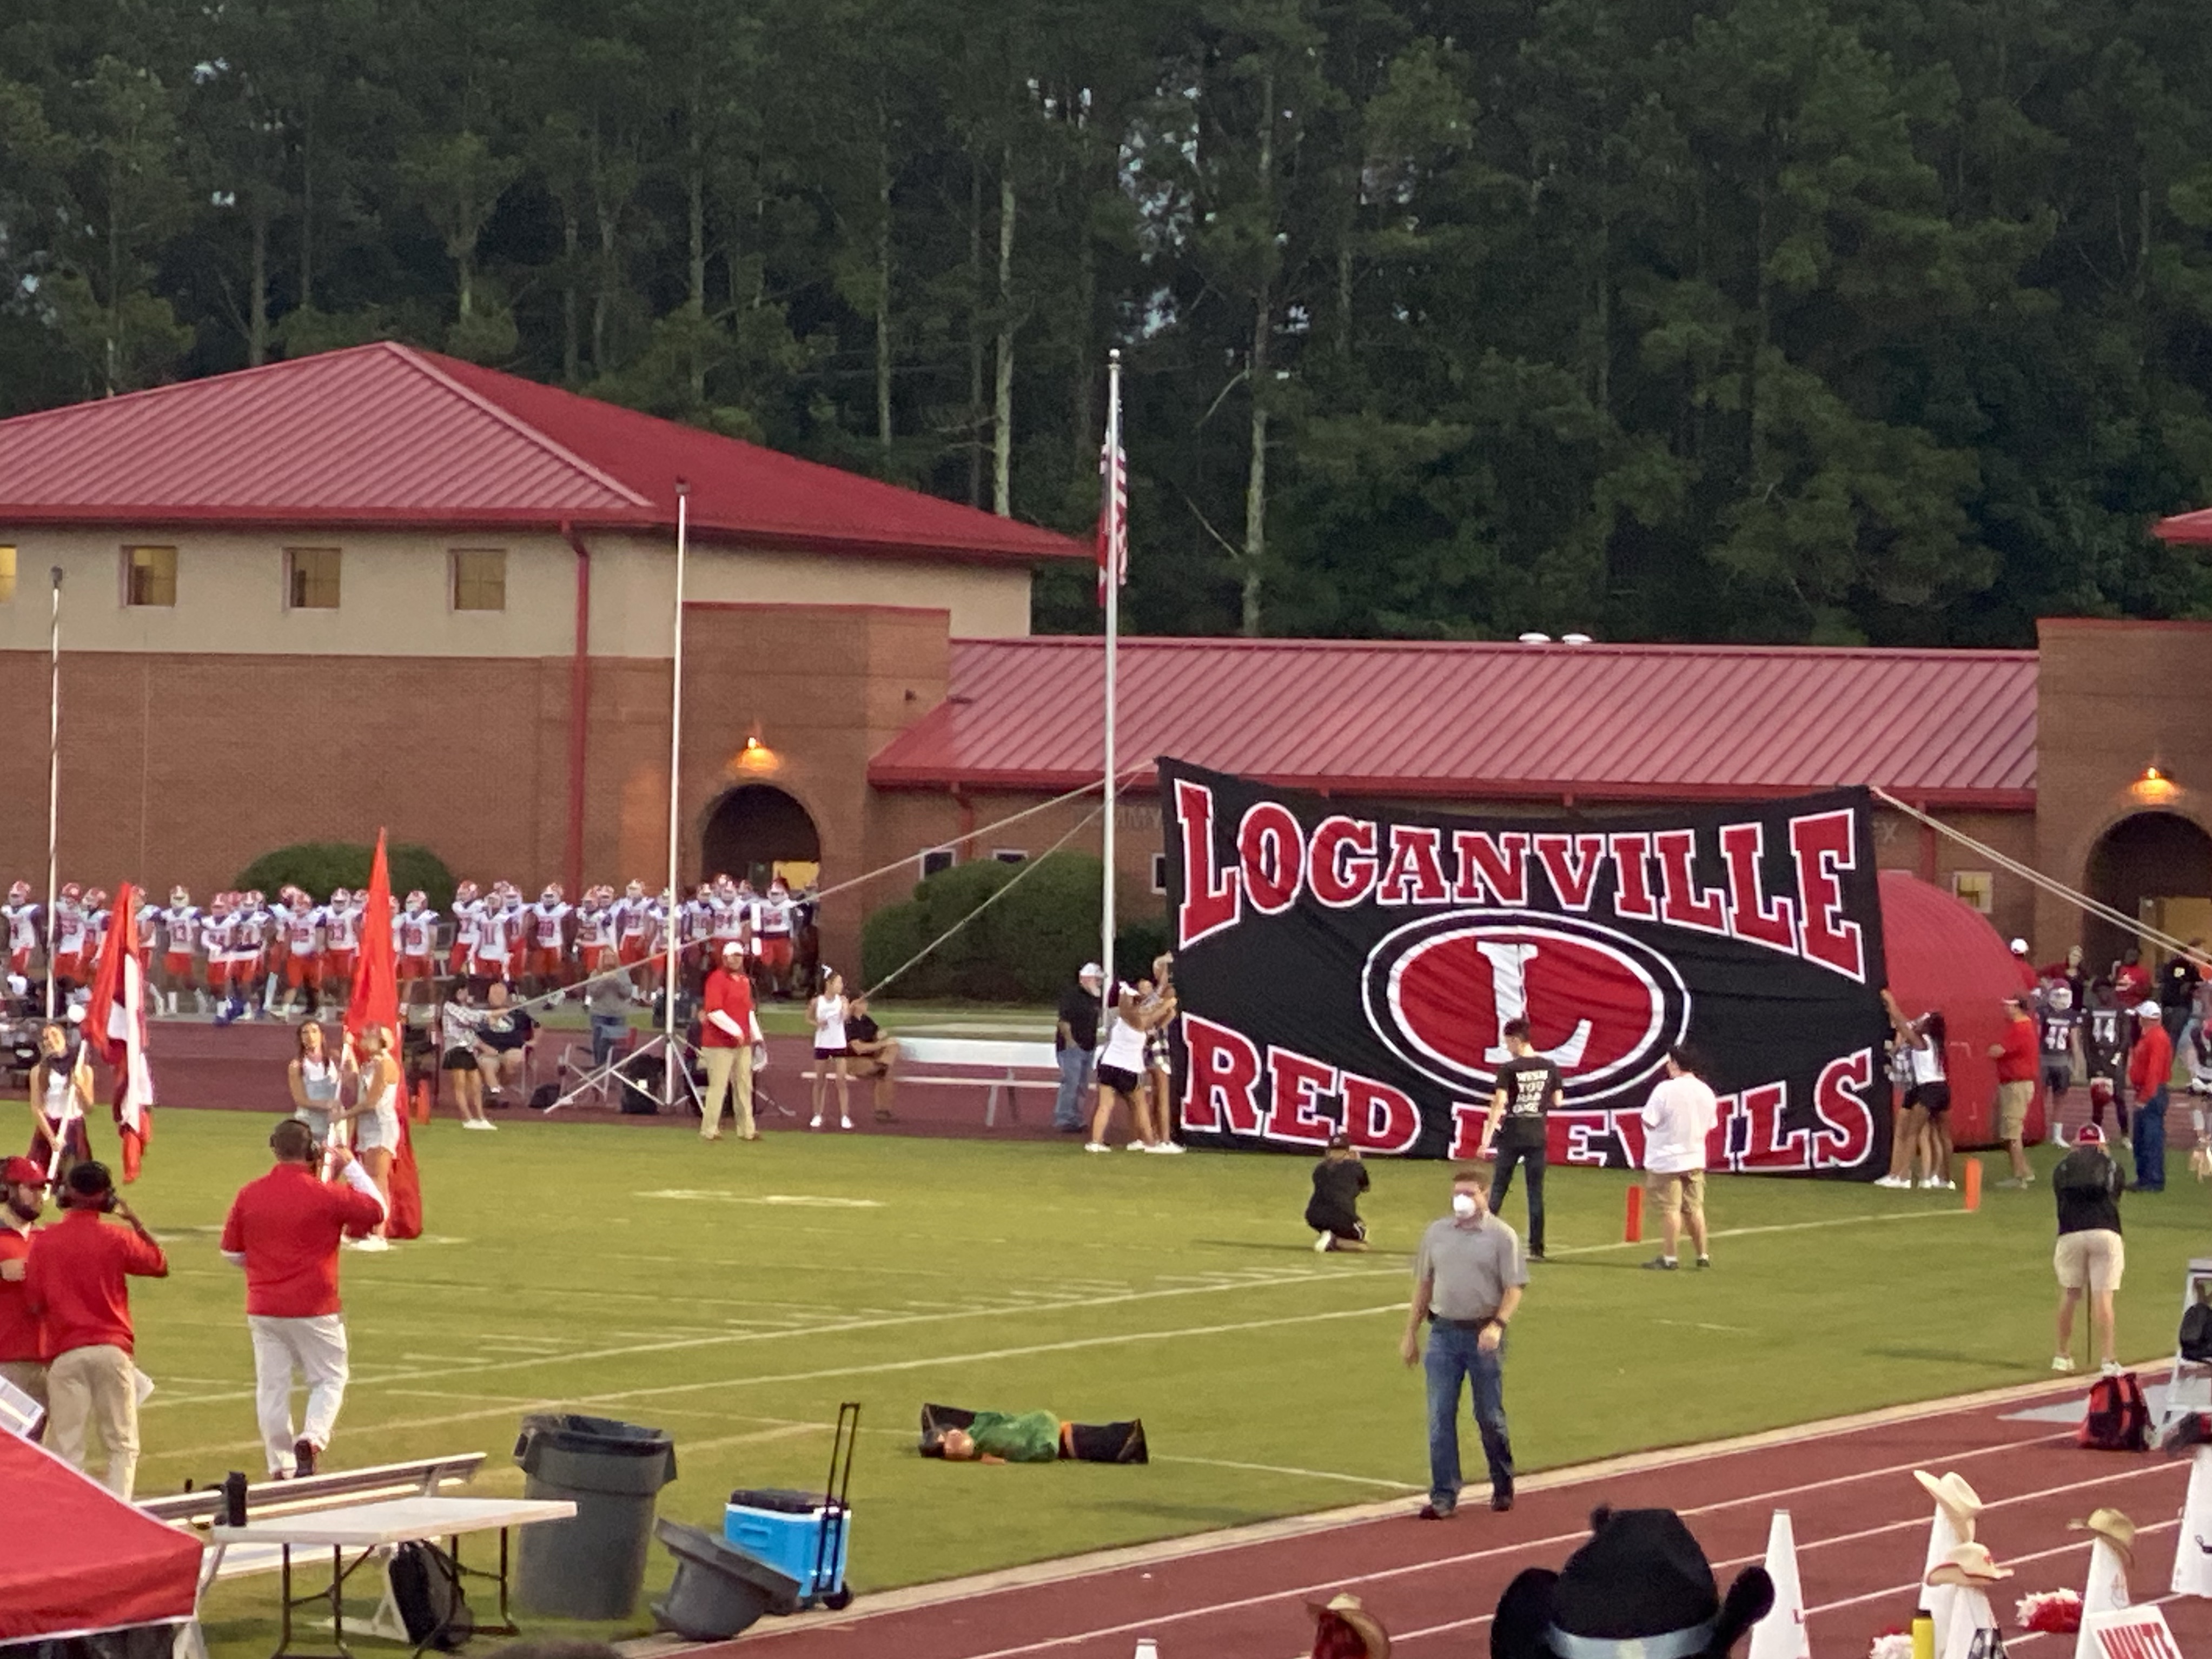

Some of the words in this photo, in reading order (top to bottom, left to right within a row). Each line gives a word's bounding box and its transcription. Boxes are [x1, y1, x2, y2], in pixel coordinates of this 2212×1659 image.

[1174, 778, 1866, 984] LOGANVILLE
[1476, 942, 1594, 1067] L
[1181, 1011, 1422, 1154] RED
